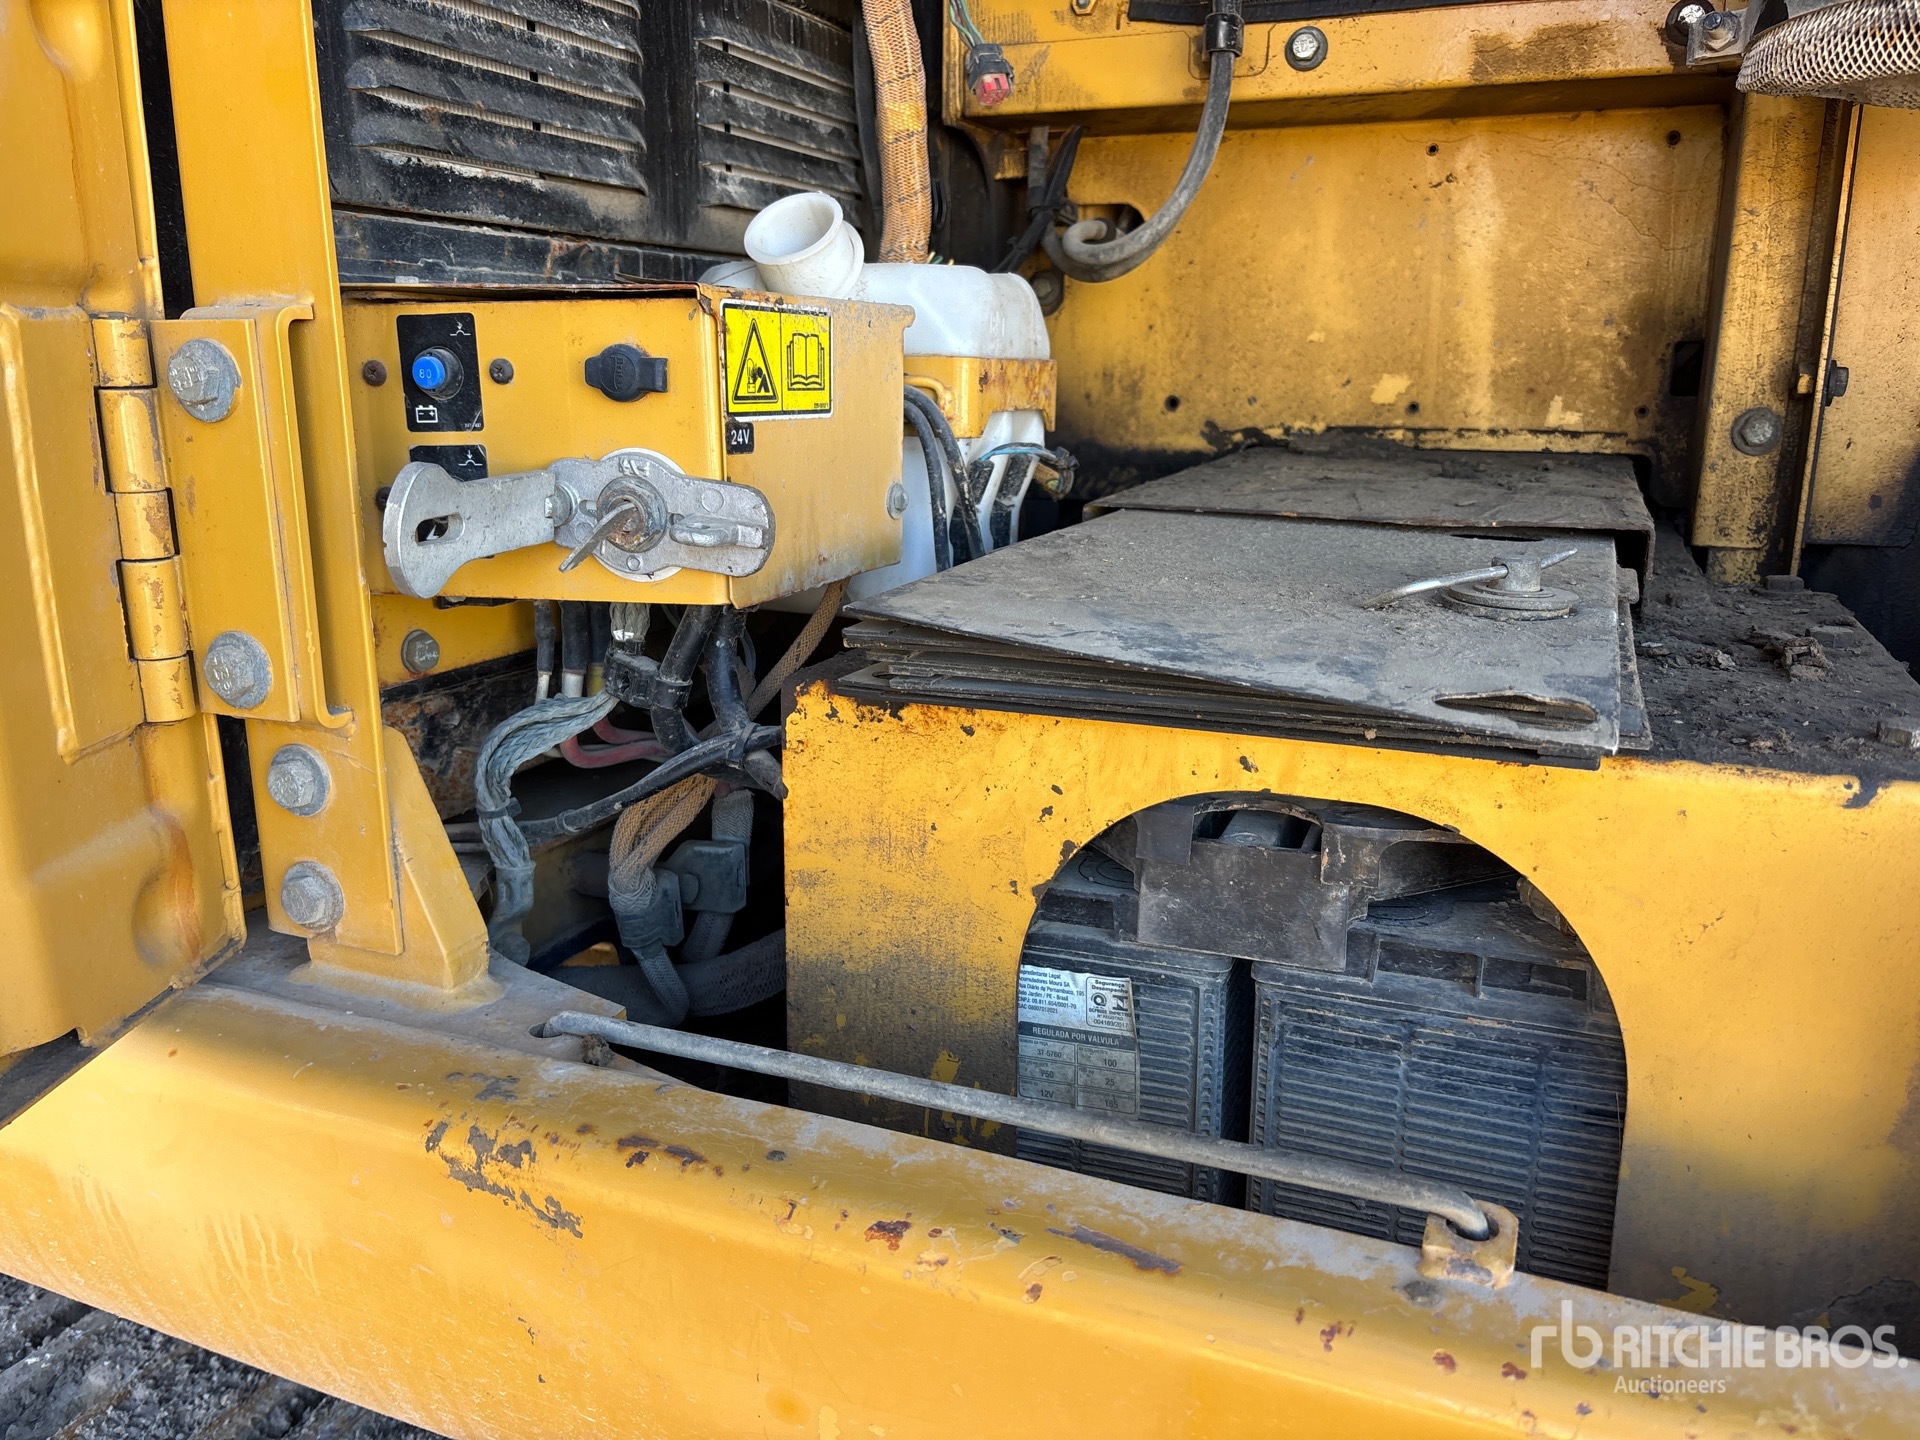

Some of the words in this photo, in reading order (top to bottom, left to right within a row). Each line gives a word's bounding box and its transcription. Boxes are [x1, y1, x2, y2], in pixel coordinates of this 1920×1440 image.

[419, 368, 432, 379] 80
[730, 428, 750, 446] 24V
[1095, 980, 1125, 988] Segurança
[1033, 1027, 1069, 1038] REGULADA
[1104, 1059, 1117, 1067] 100
[1105, 1078, 1115, 1086] 25
[1041, 1090, 1054, 1098] 12V
